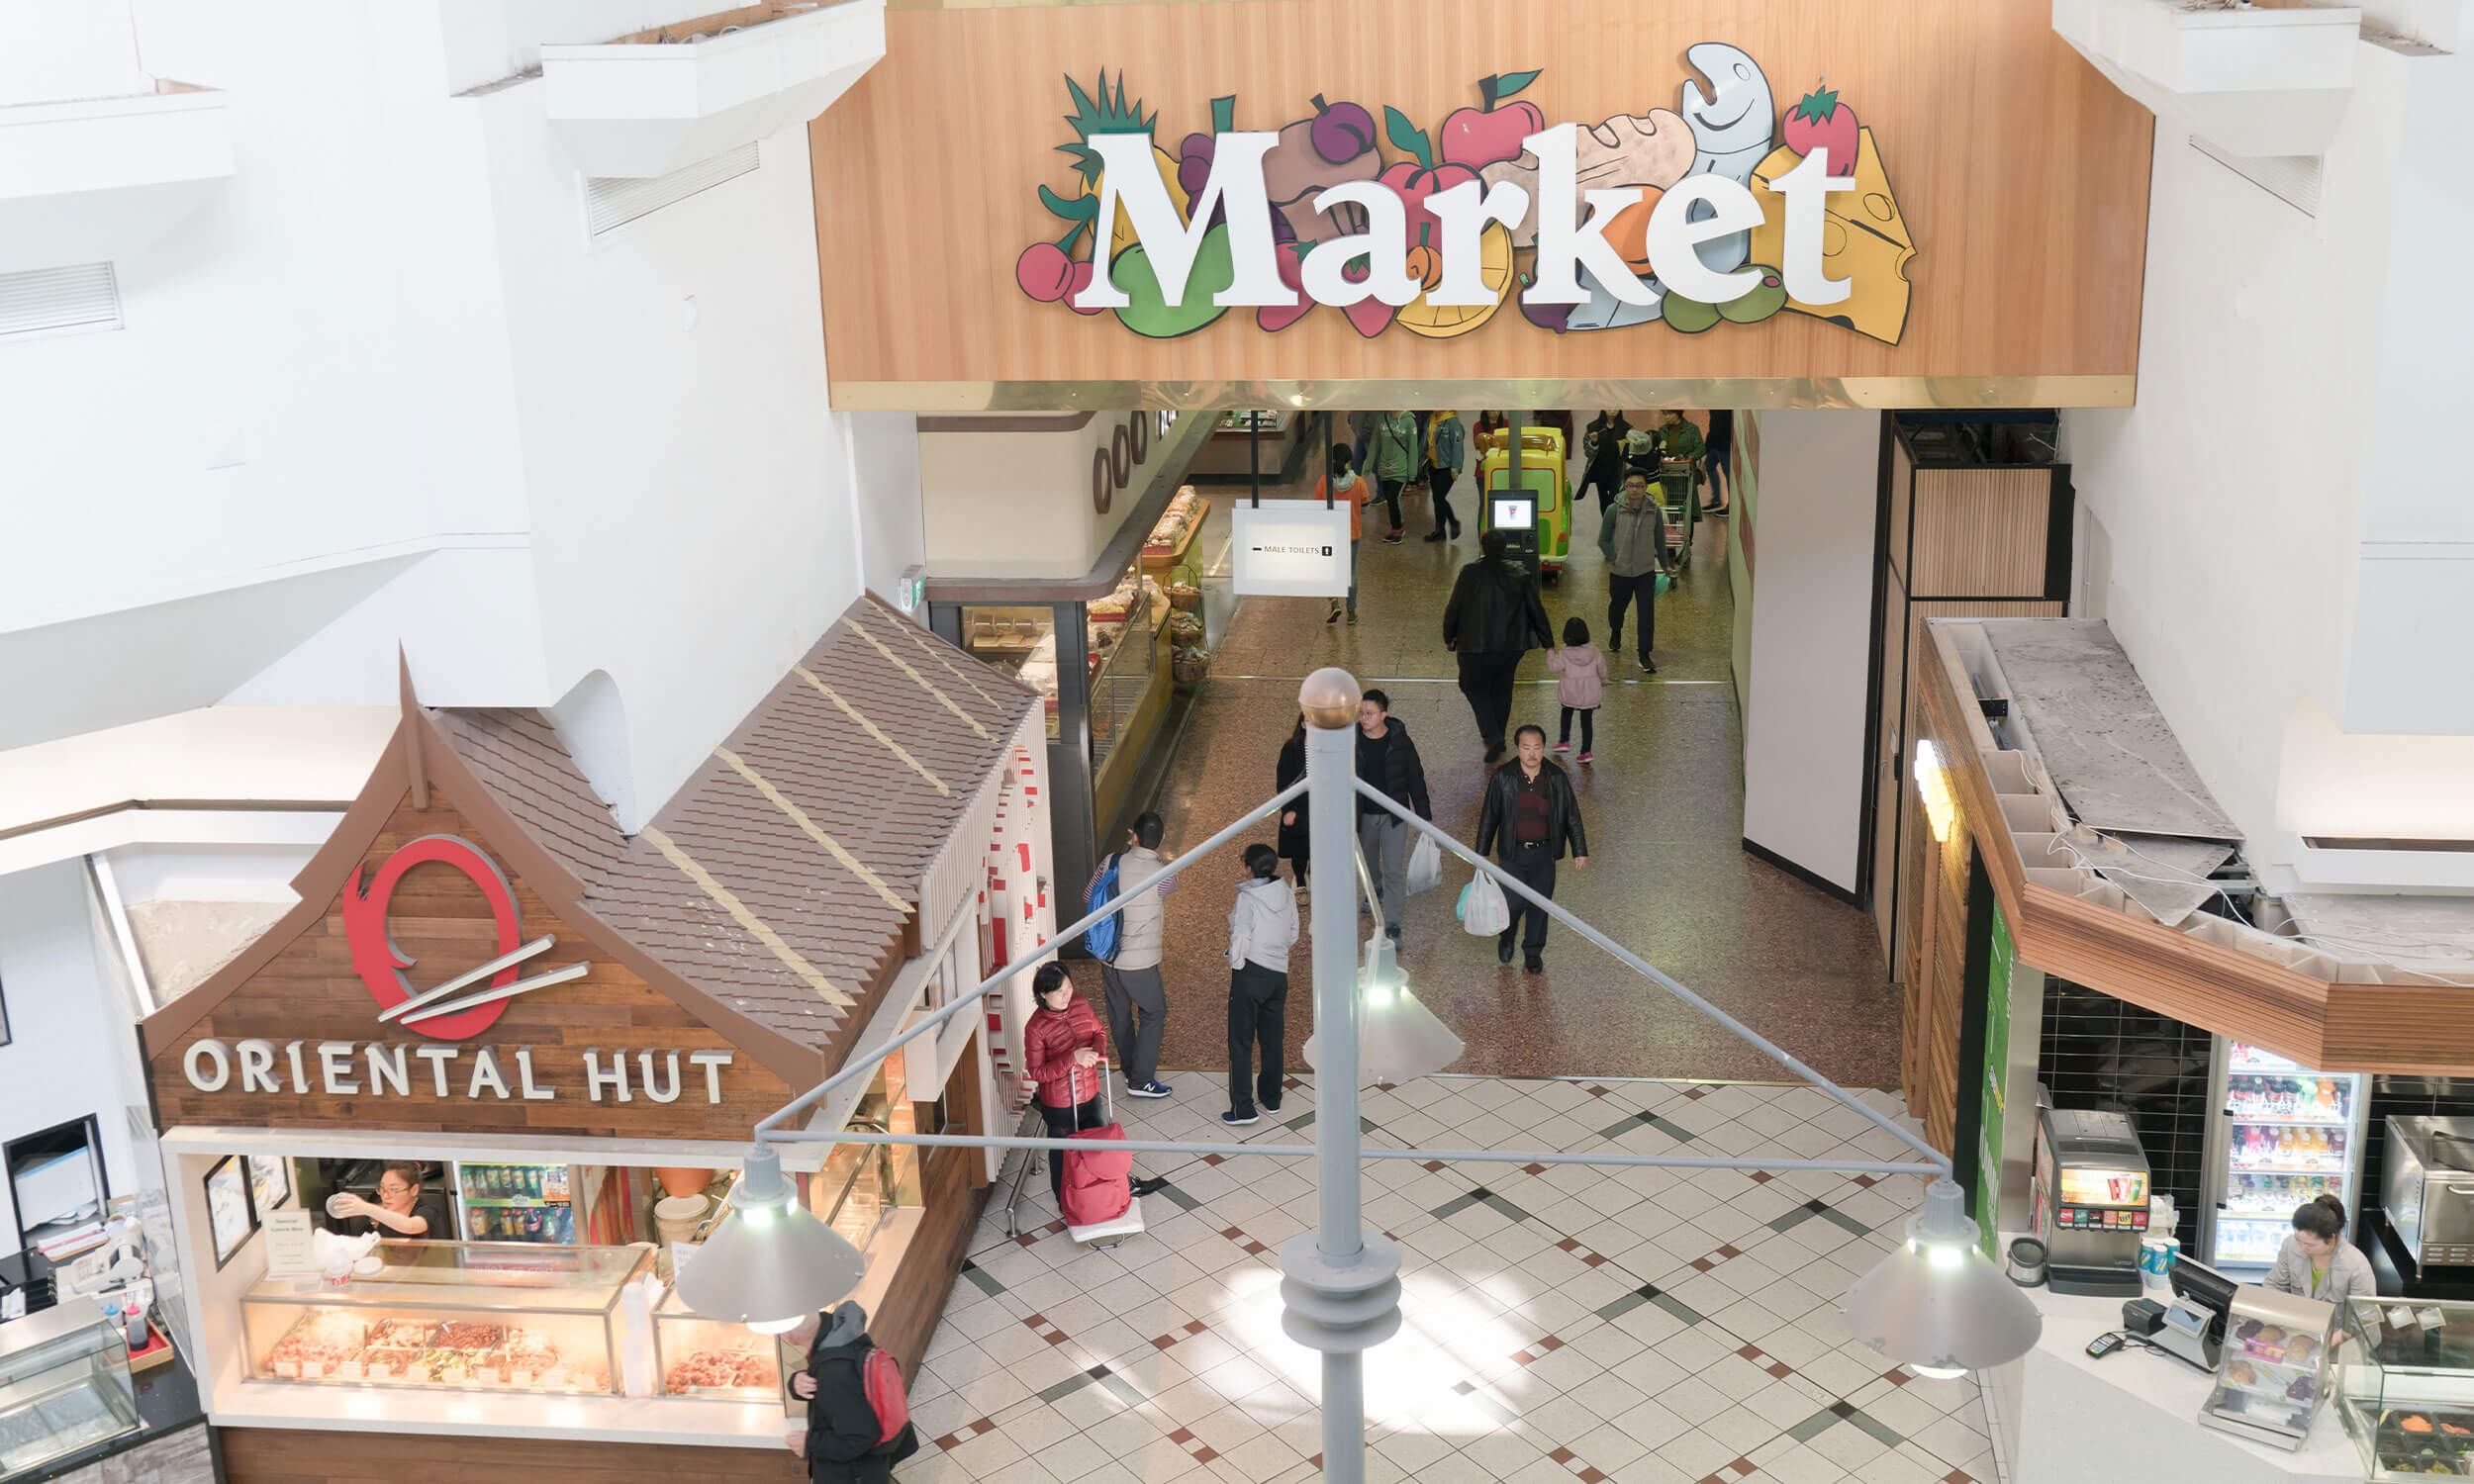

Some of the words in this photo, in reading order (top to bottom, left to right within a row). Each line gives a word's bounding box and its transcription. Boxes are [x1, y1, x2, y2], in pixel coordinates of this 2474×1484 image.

[1074, 123, 1856, 308] Market
[1264, 545, 1286, 554] MALE
[1288, 545, 1320, 555] TOILETS
[183, 1039, 556, 1100] ORIENTAL
[583, 1049, 733, 1104] HUT
